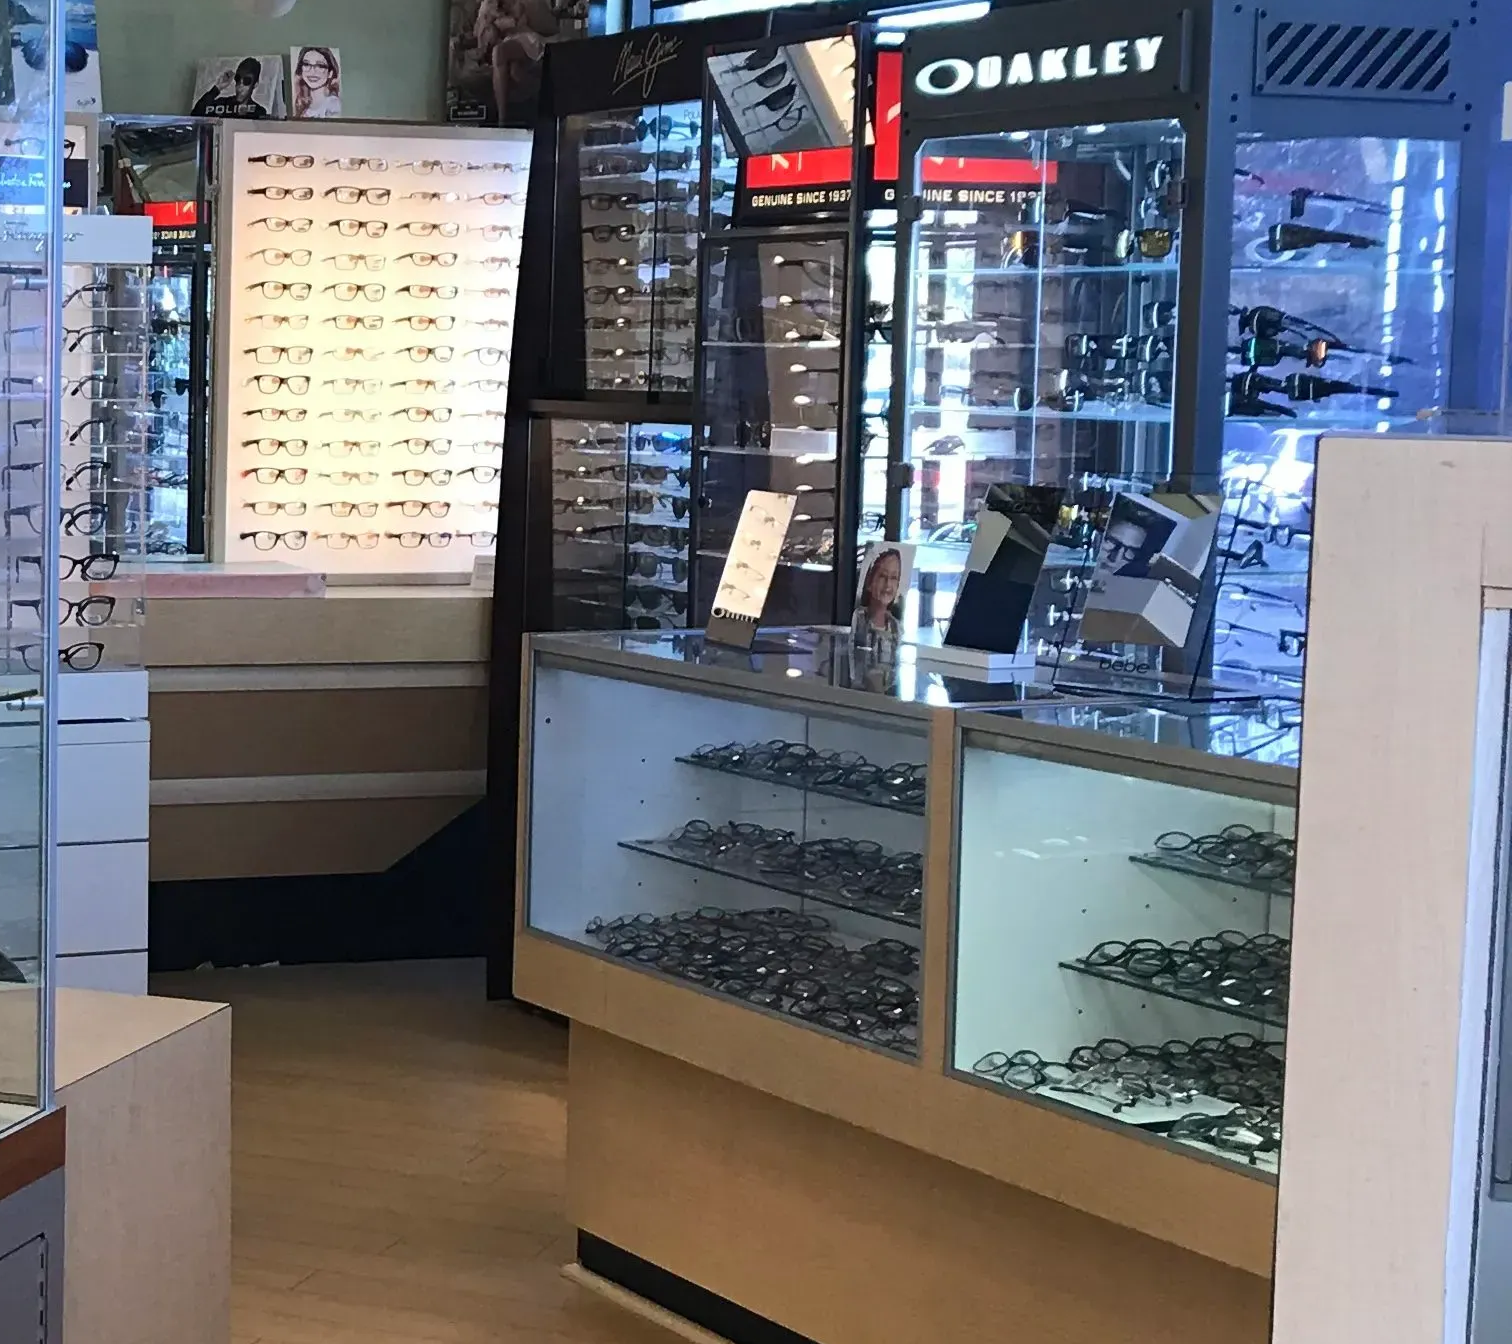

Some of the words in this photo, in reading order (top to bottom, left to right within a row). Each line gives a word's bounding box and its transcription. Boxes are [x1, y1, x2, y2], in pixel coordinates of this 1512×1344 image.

[205, 103, 257, 115] POLICE
[751, 193, 793, 207] GENUINE
[796, 190, 826, 204] SINCE
[828, 188, 852, 202] 1937
[957, 188, 1005, 203] SINCE
